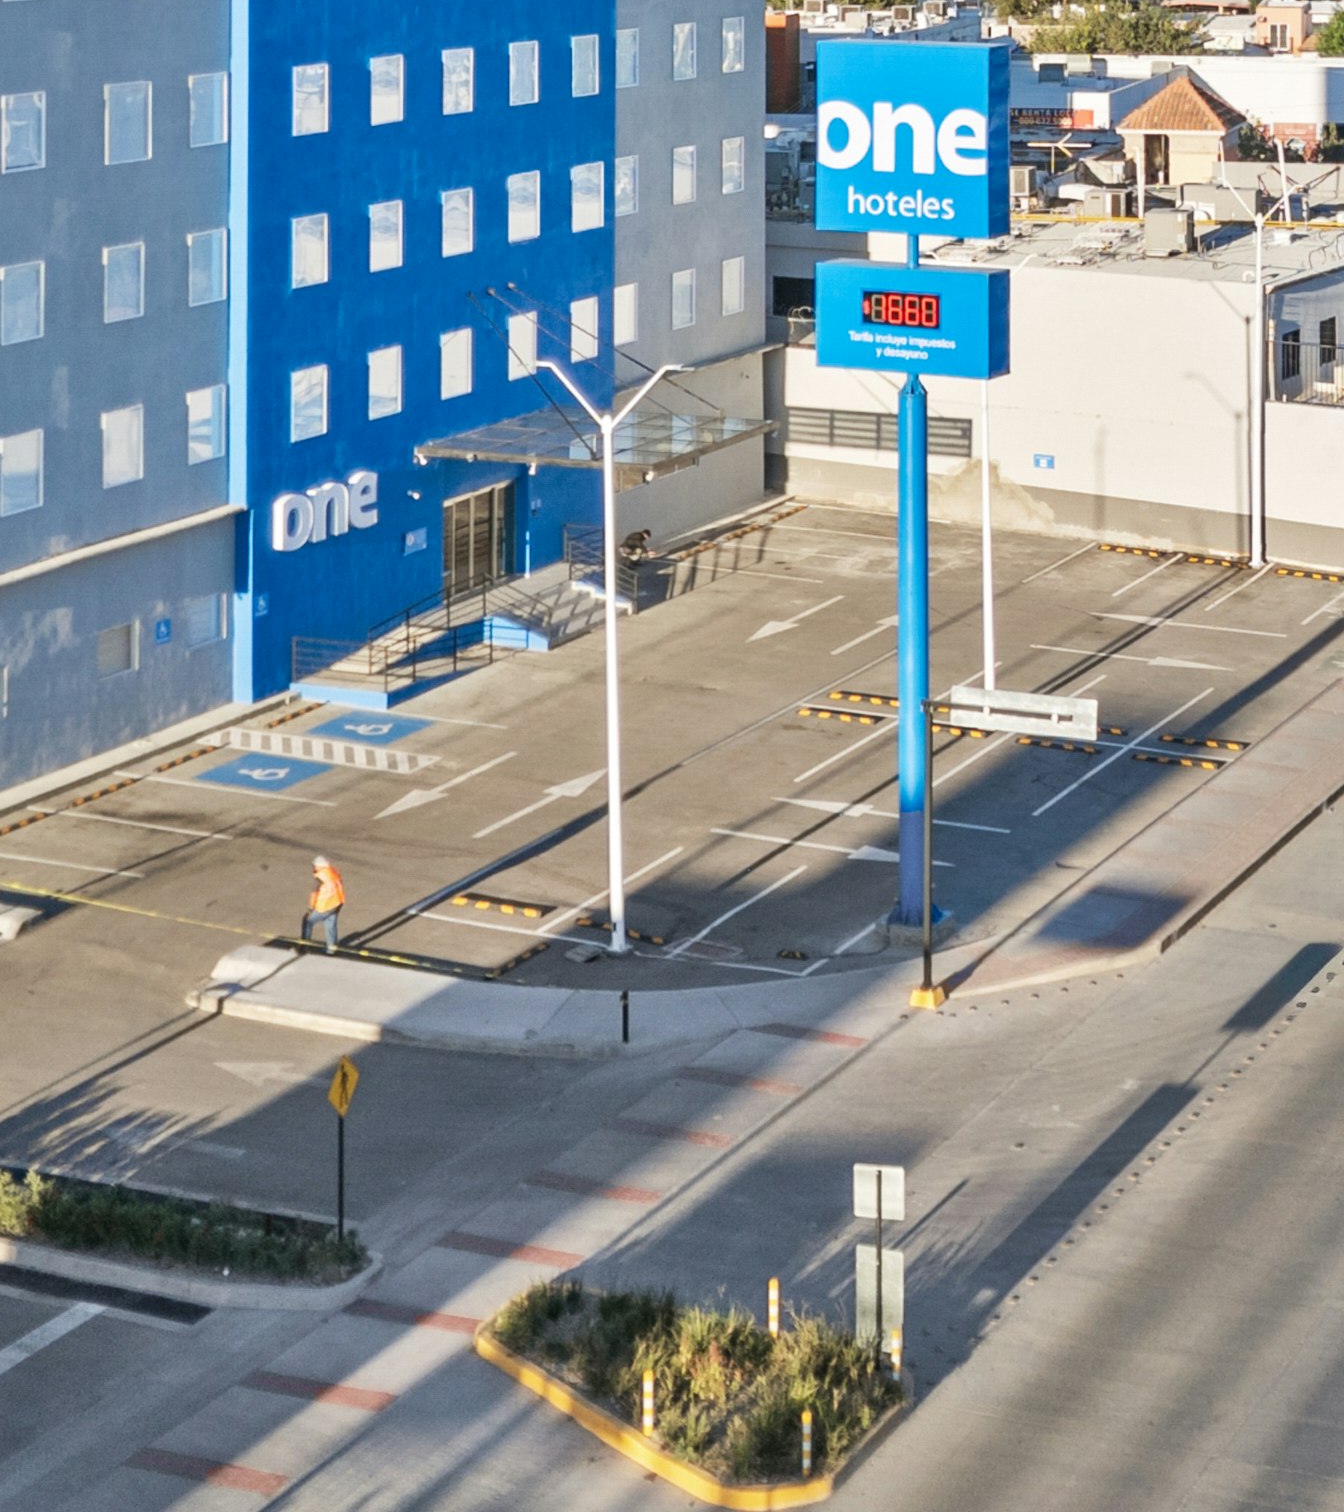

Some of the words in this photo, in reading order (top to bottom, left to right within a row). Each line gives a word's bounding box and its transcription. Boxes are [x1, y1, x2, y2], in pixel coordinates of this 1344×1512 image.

[817, 100, 987, 176] one
[847, 185, 955, 220] hoteles
[848, 330, 874, 343] Tarifa
[875, 333, 907, 347] incluye
[909, 336, 956, 349] impuestos
[875, 348, 882, 358] y
[883, 346, 928, 360] desayuno
[271, 470, 378, 552] one
